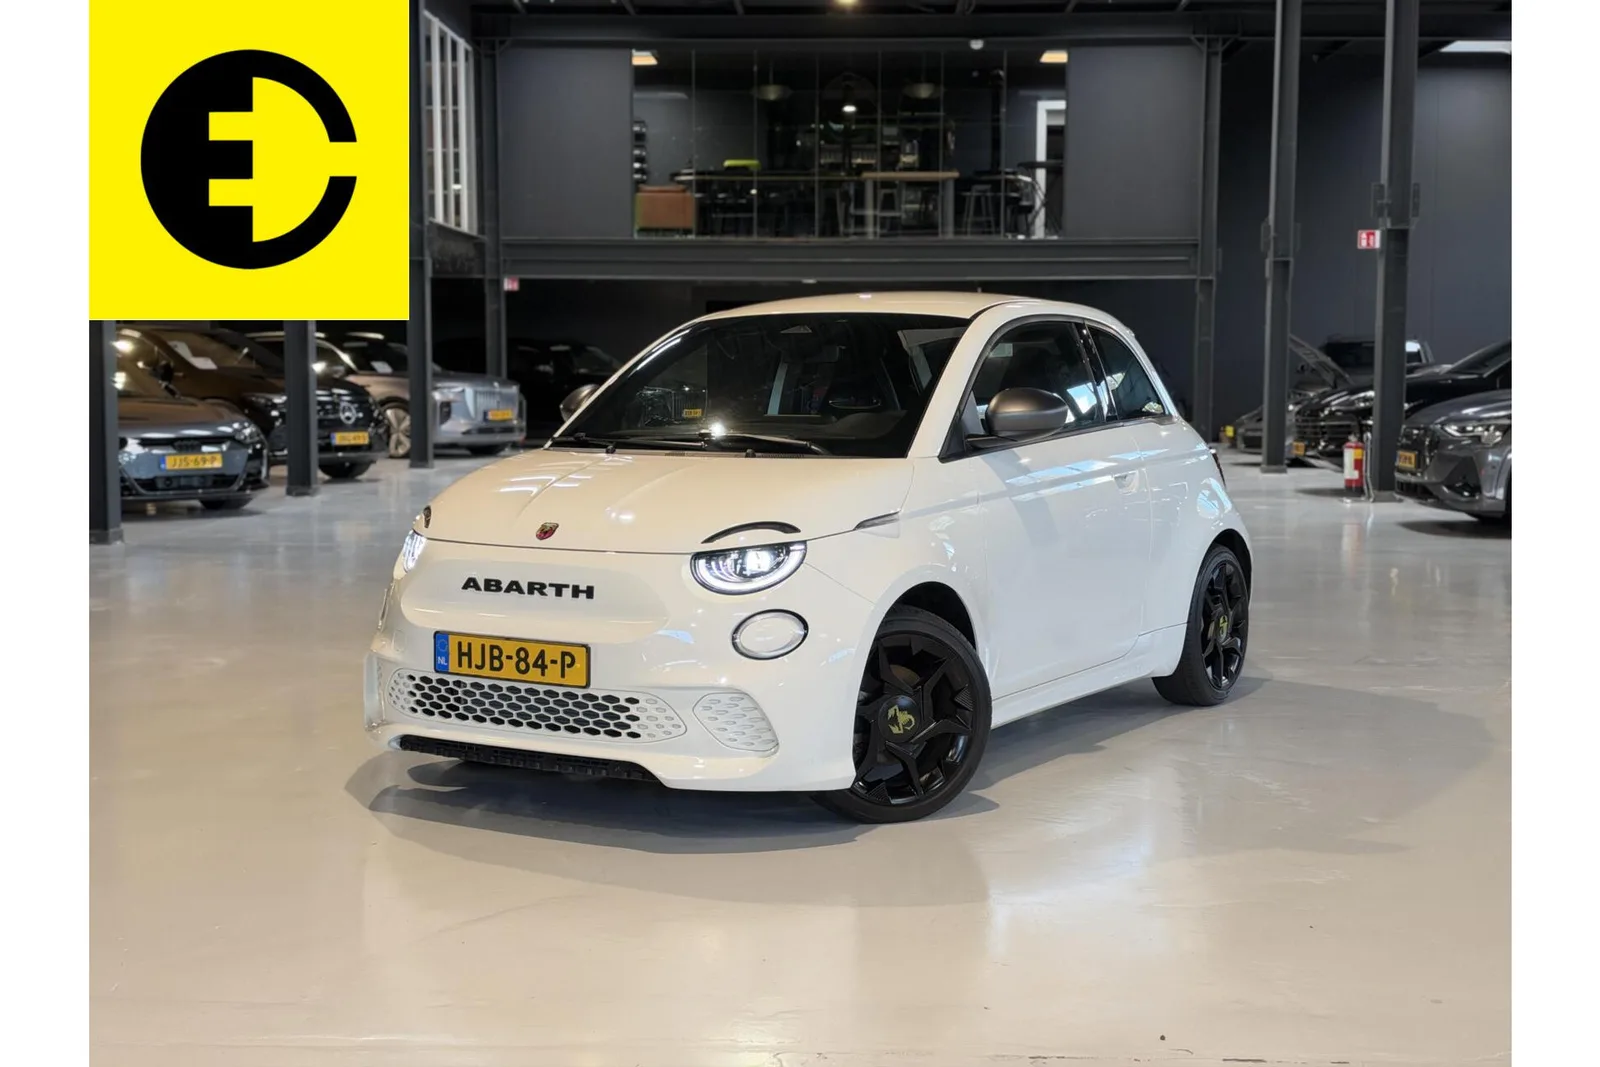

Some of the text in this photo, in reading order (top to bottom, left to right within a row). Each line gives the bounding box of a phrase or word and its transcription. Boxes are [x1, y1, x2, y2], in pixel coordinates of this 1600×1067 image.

[461, 577, 595, 600] ABARTH
[437, 656, 448, 667] NL
[457, 641, 576, 679] HJB-84-P
